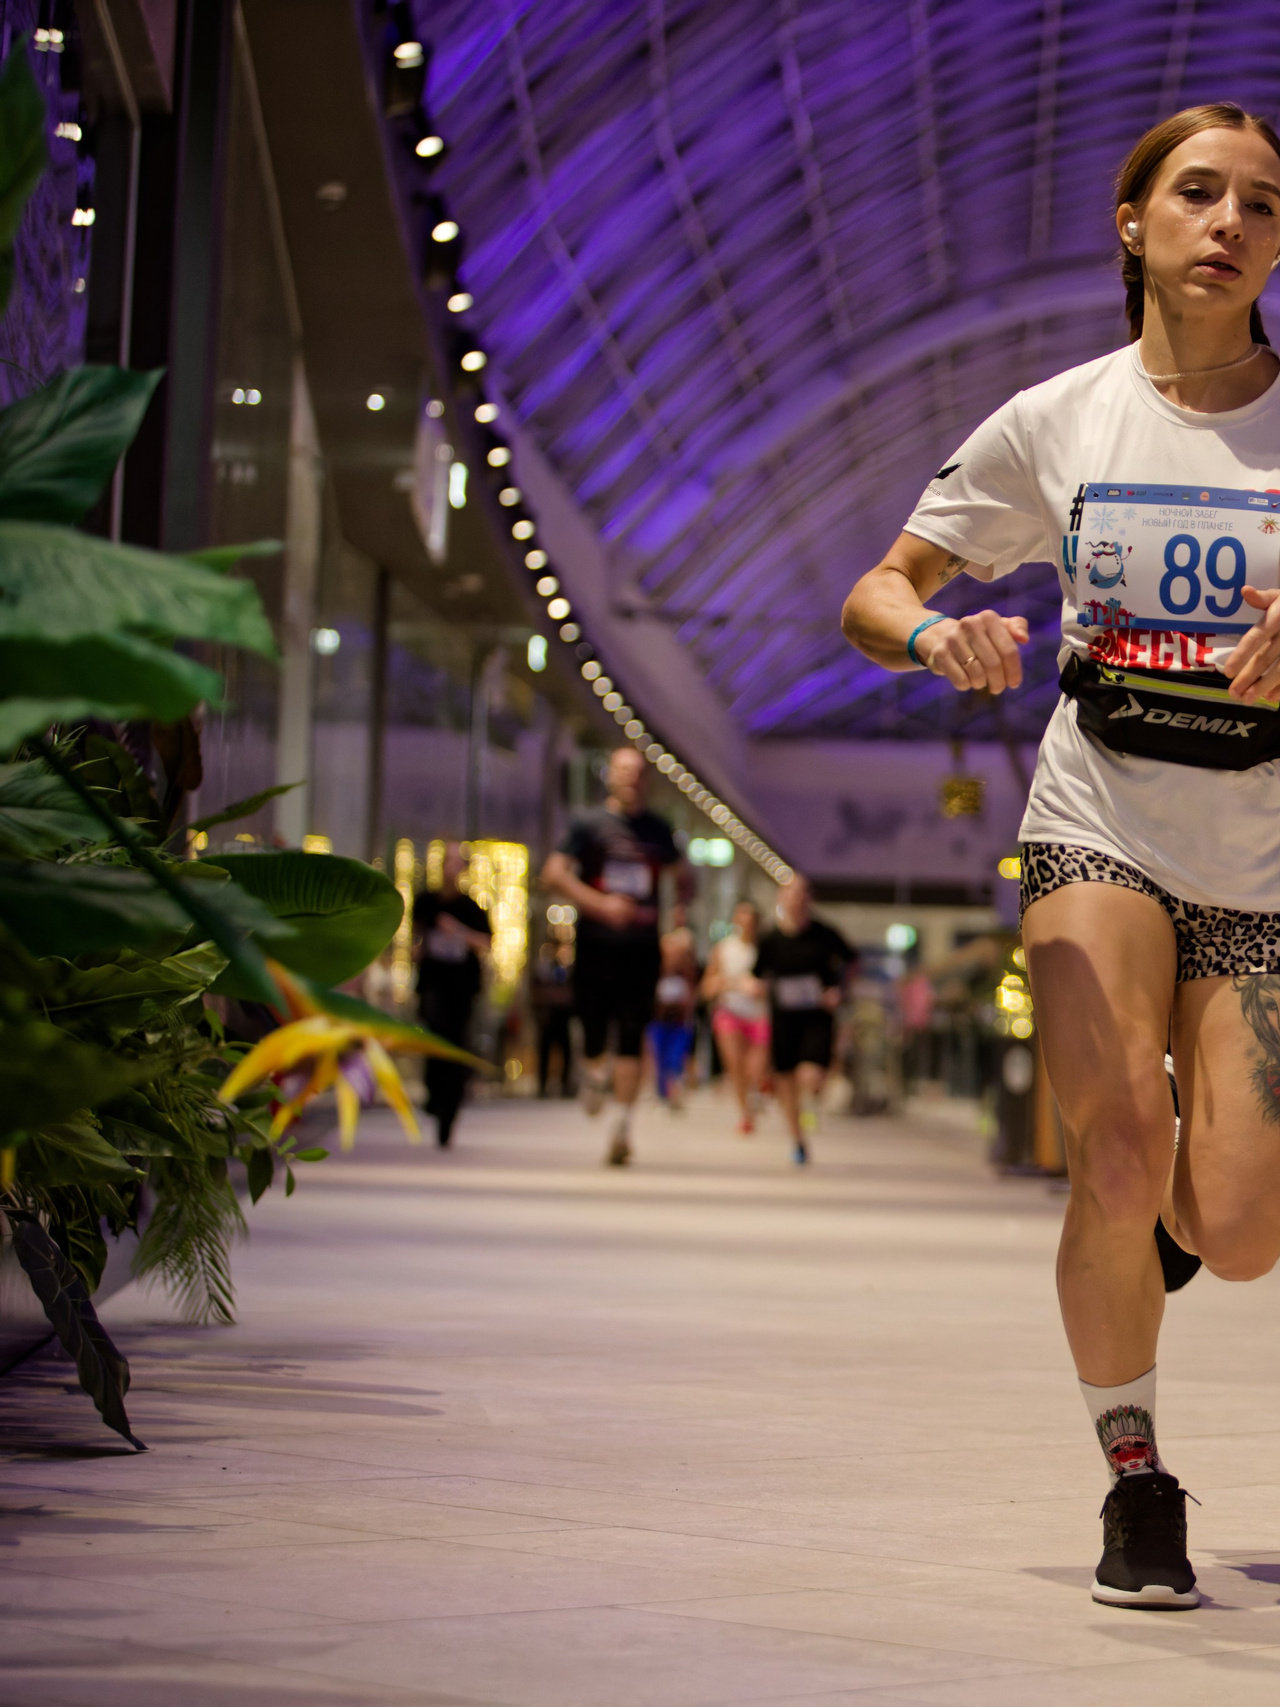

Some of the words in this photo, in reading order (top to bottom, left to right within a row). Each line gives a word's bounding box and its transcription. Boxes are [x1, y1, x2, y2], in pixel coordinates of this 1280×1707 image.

[1159, 507, 1192, 518] НОЧНОЙ
[1194, 509, 1218, 519] ЗАБЕГ
[1142, 518, 1171, 527] НОВЫЙ
[1172, 519, 1188, 529] ГОД
[1197, 521, 1234, 531] ПЛАНЕТЕ
[1159, 533, 1246, 617] 89
[1143, 708, 1257, 738] DEMIX
